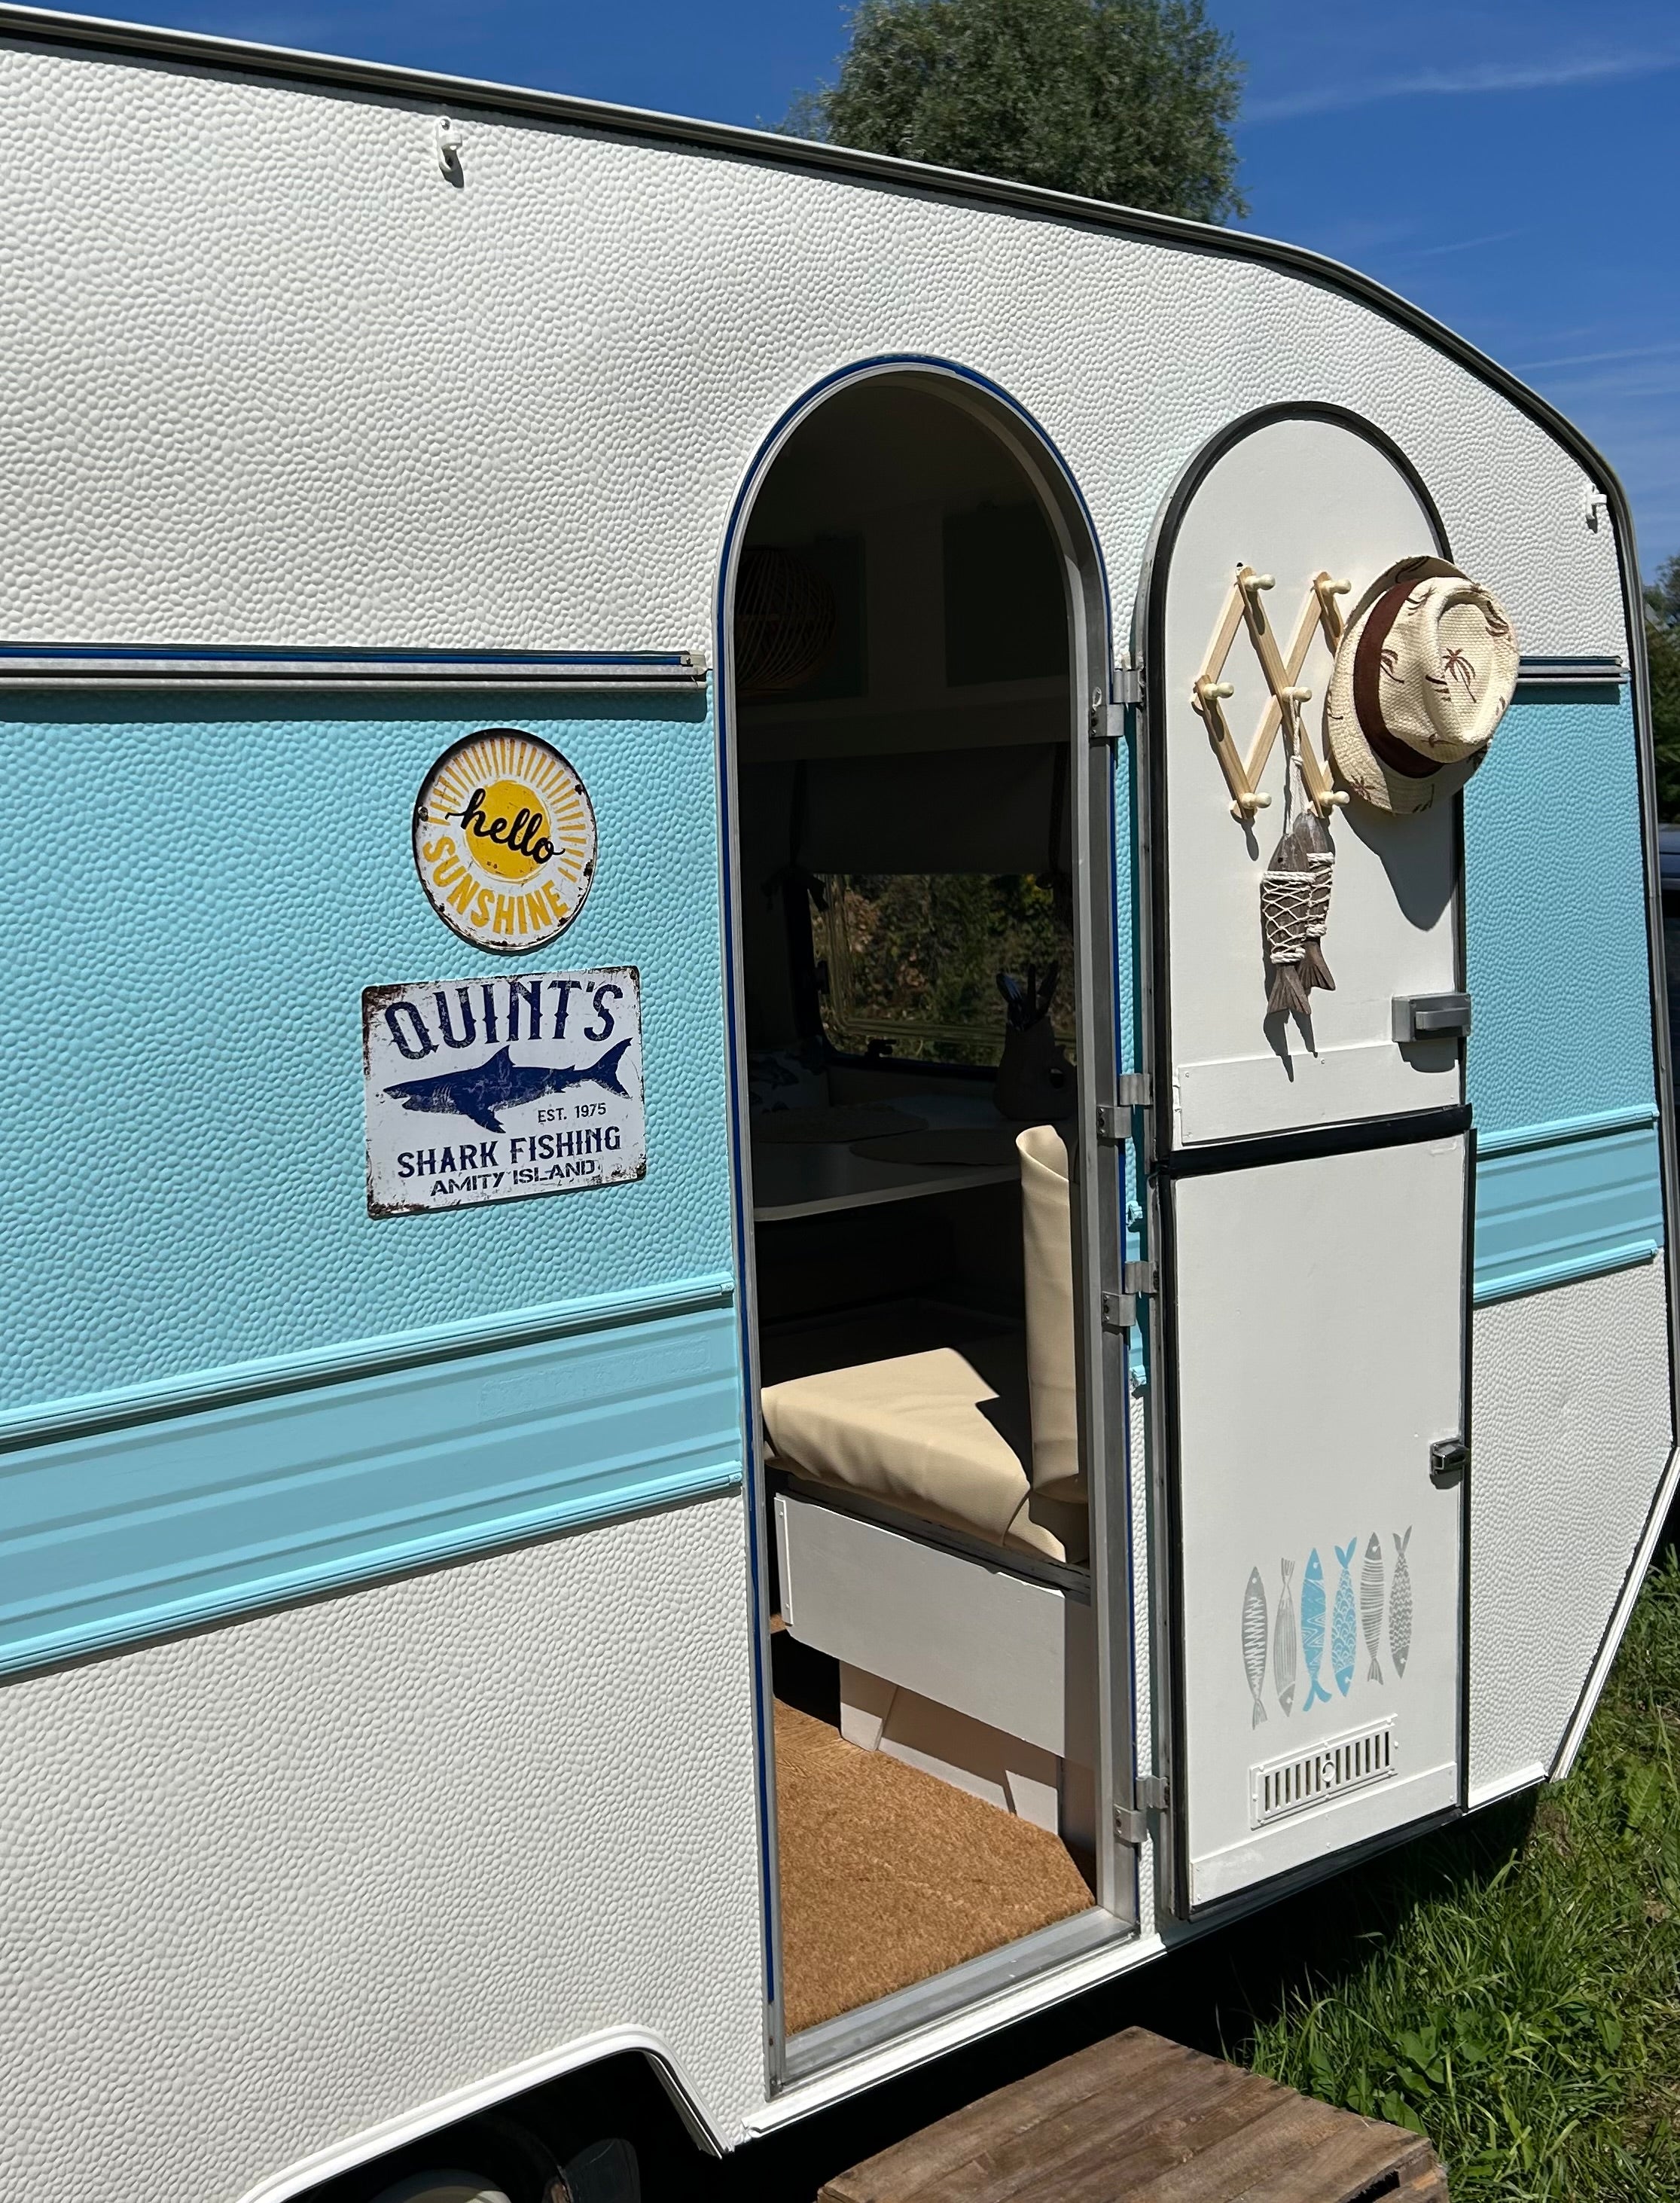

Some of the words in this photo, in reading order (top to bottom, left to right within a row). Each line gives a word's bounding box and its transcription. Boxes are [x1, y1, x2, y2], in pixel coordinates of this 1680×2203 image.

[446, 788, 566, 865] hello
[422, 837, 571, 935] SUNSHINE
[385, 980, 624, 1060] QUINT'S
[538, 1108, 567, 1123] EST.
[575, 1103, 607, 1118] 1975
[398, 1140, 499, 1178] SHARK
[510, 1126, 621, 1164] FISHING
[430, 1172, 505, 1197] AMITY
[514, 1160, 596, 1185] ISLAND
